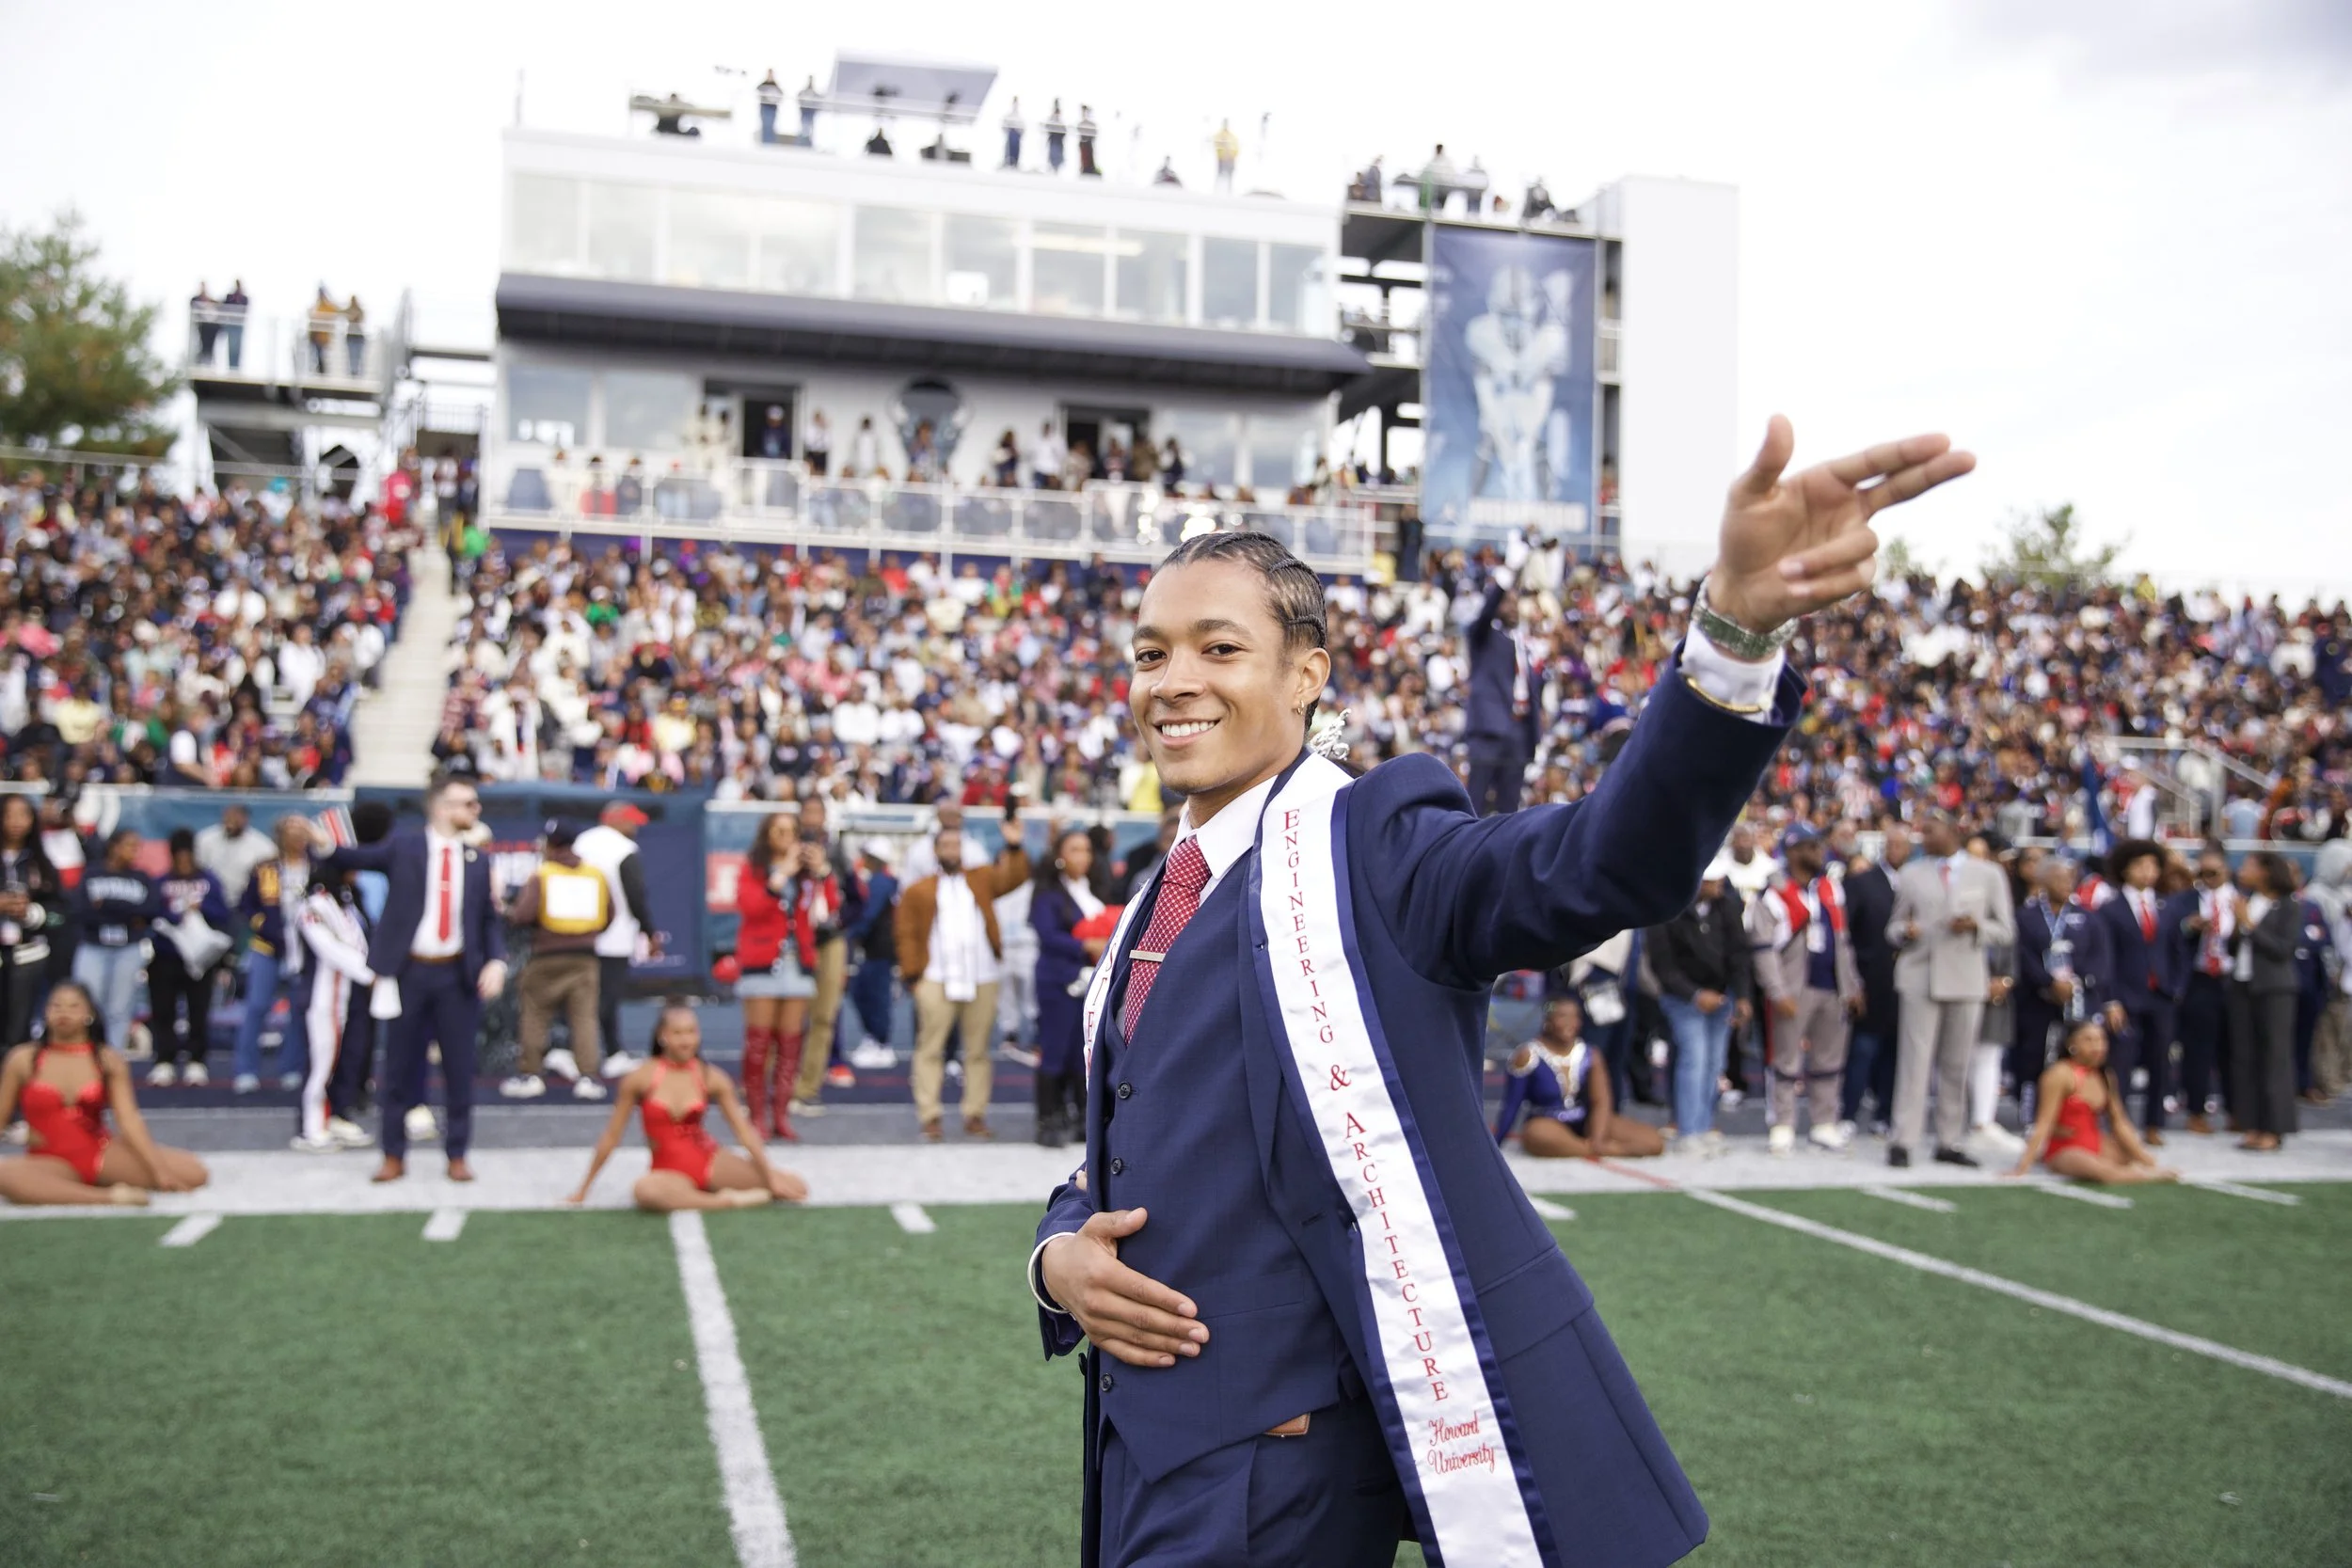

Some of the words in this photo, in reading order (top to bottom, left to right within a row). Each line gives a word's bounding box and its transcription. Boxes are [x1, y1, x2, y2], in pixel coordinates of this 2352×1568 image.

[1280, 808, 1334, 1044] ENGINEERING
[1330, 1064, 1352, 1091] &
[1345, 1111, 1450, 1402] ARCHITECTURE
[1428, 1410, 1480, 1447] Howard
[1427, 1442, 1495, 1475] University
